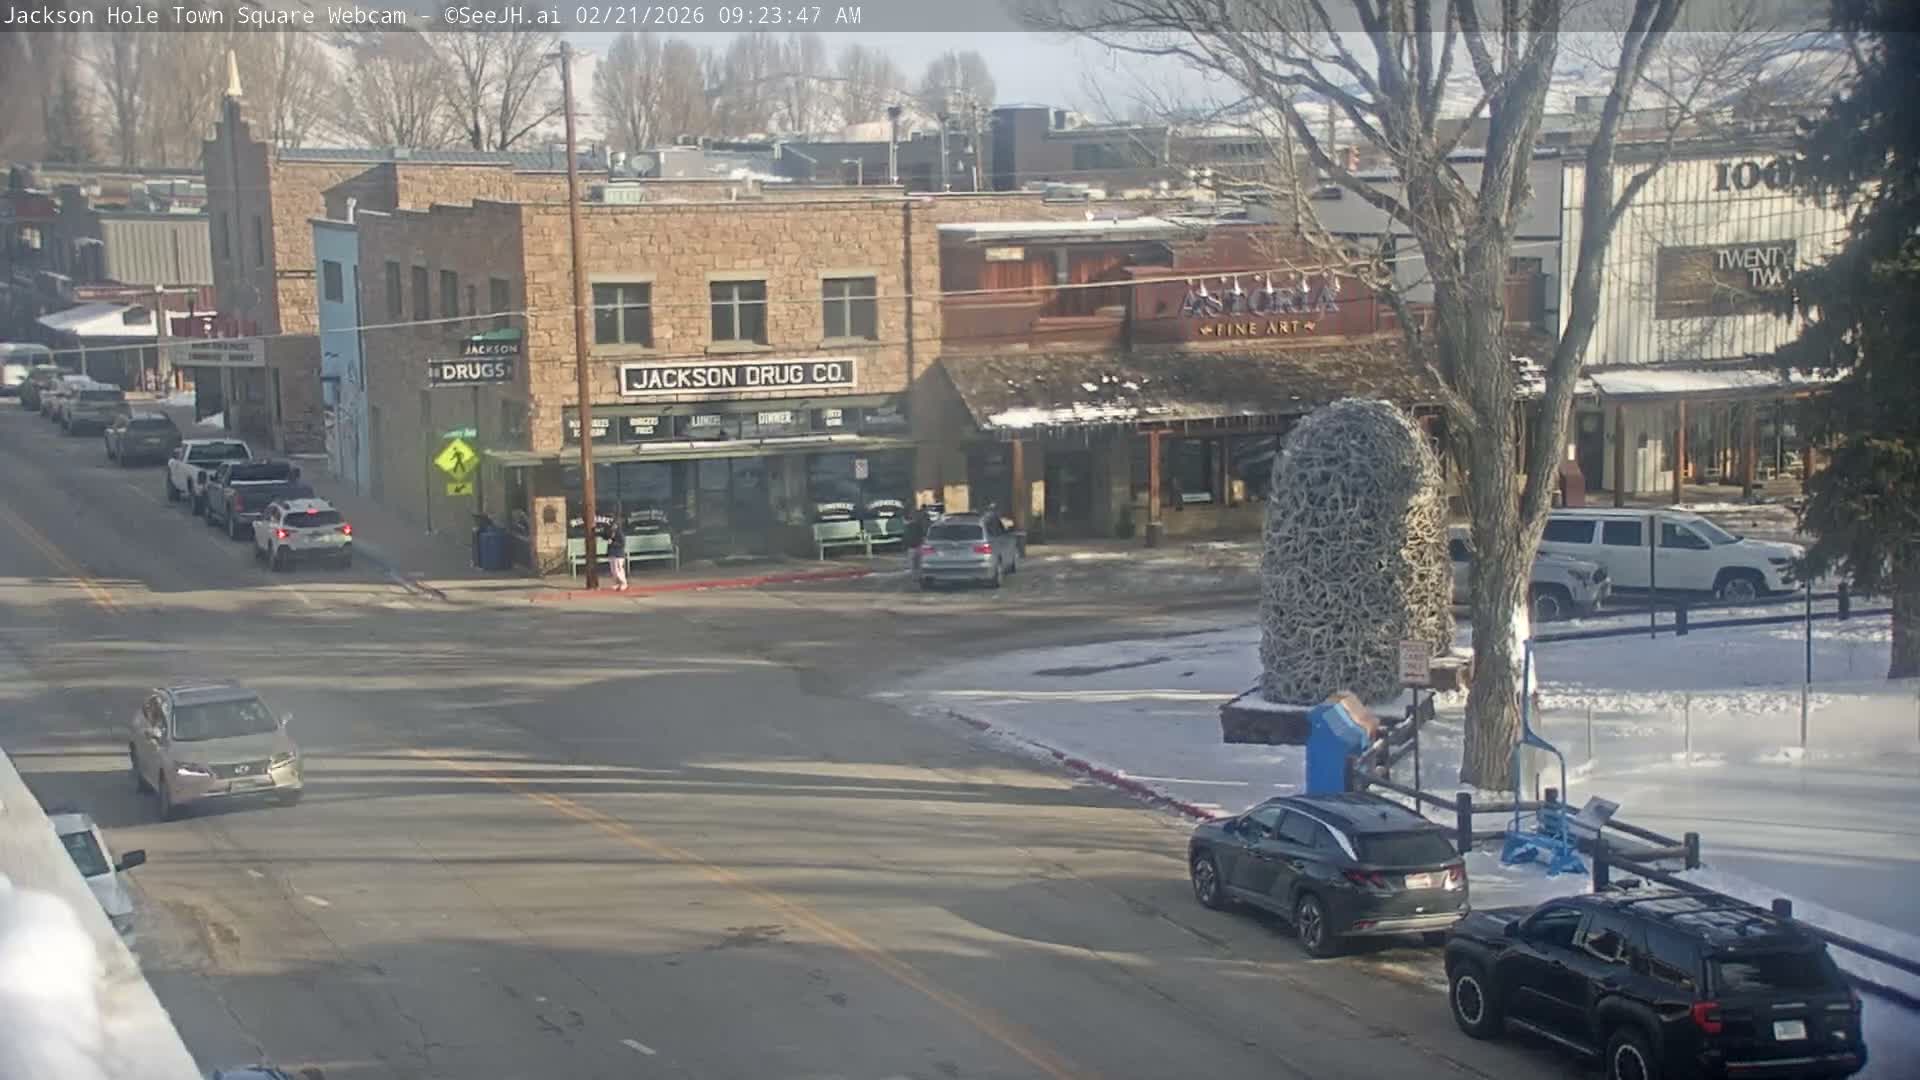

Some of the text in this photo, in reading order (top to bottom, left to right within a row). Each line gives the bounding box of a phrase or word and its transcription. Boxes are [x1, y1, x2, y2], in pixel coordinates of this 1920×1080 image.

[1717, 247, 1793, 269] TWENTY
[1180, 285, 1340, 318] ASTORIA
[1215, 320, 1300, 336] FINE ART
[465, 344, 518, 354] JACKSON
[442, 363, 505, 380] DRUGS
[633, 363, 846, 389] JACKSON DRUG CO.
